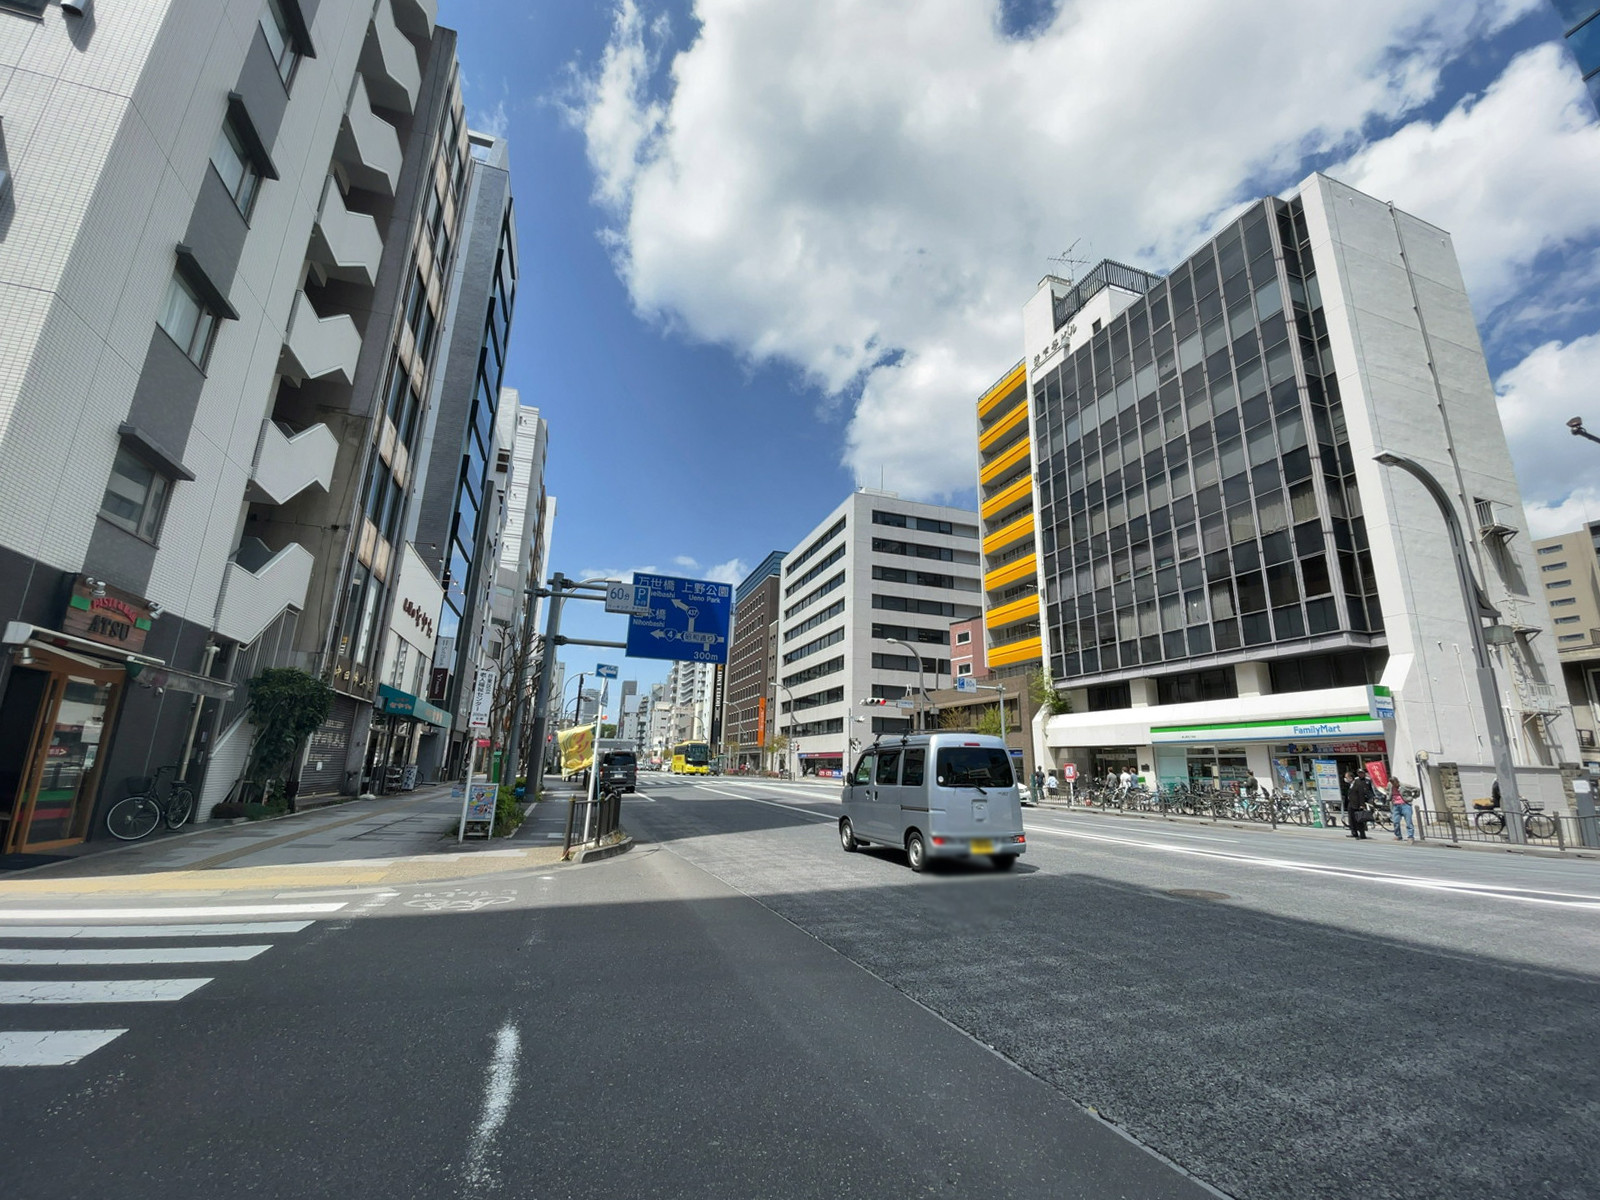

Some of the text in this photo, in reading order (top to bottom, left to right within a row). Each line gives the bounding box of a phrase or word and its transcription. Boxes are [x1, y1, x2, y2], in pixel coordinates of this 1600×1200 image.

[639, 576, 675, 591] 万世橋
[681, 581, 729, 597] 上野公園
[610, 587, 630, 600] 60分
[637, 588, 646, 599] P
[706, 596, 721, 604] Park
[633, 608, 666, 620] 本橋
[88, 615, 130, 641] ATSU
[633, 618, 665, 628] Nihonbashi
[684, 633, 714, 642] 昭和通り
[693, 651, 718, 661] 300m
[1293, 724, 1341, 736] FamilyMart
